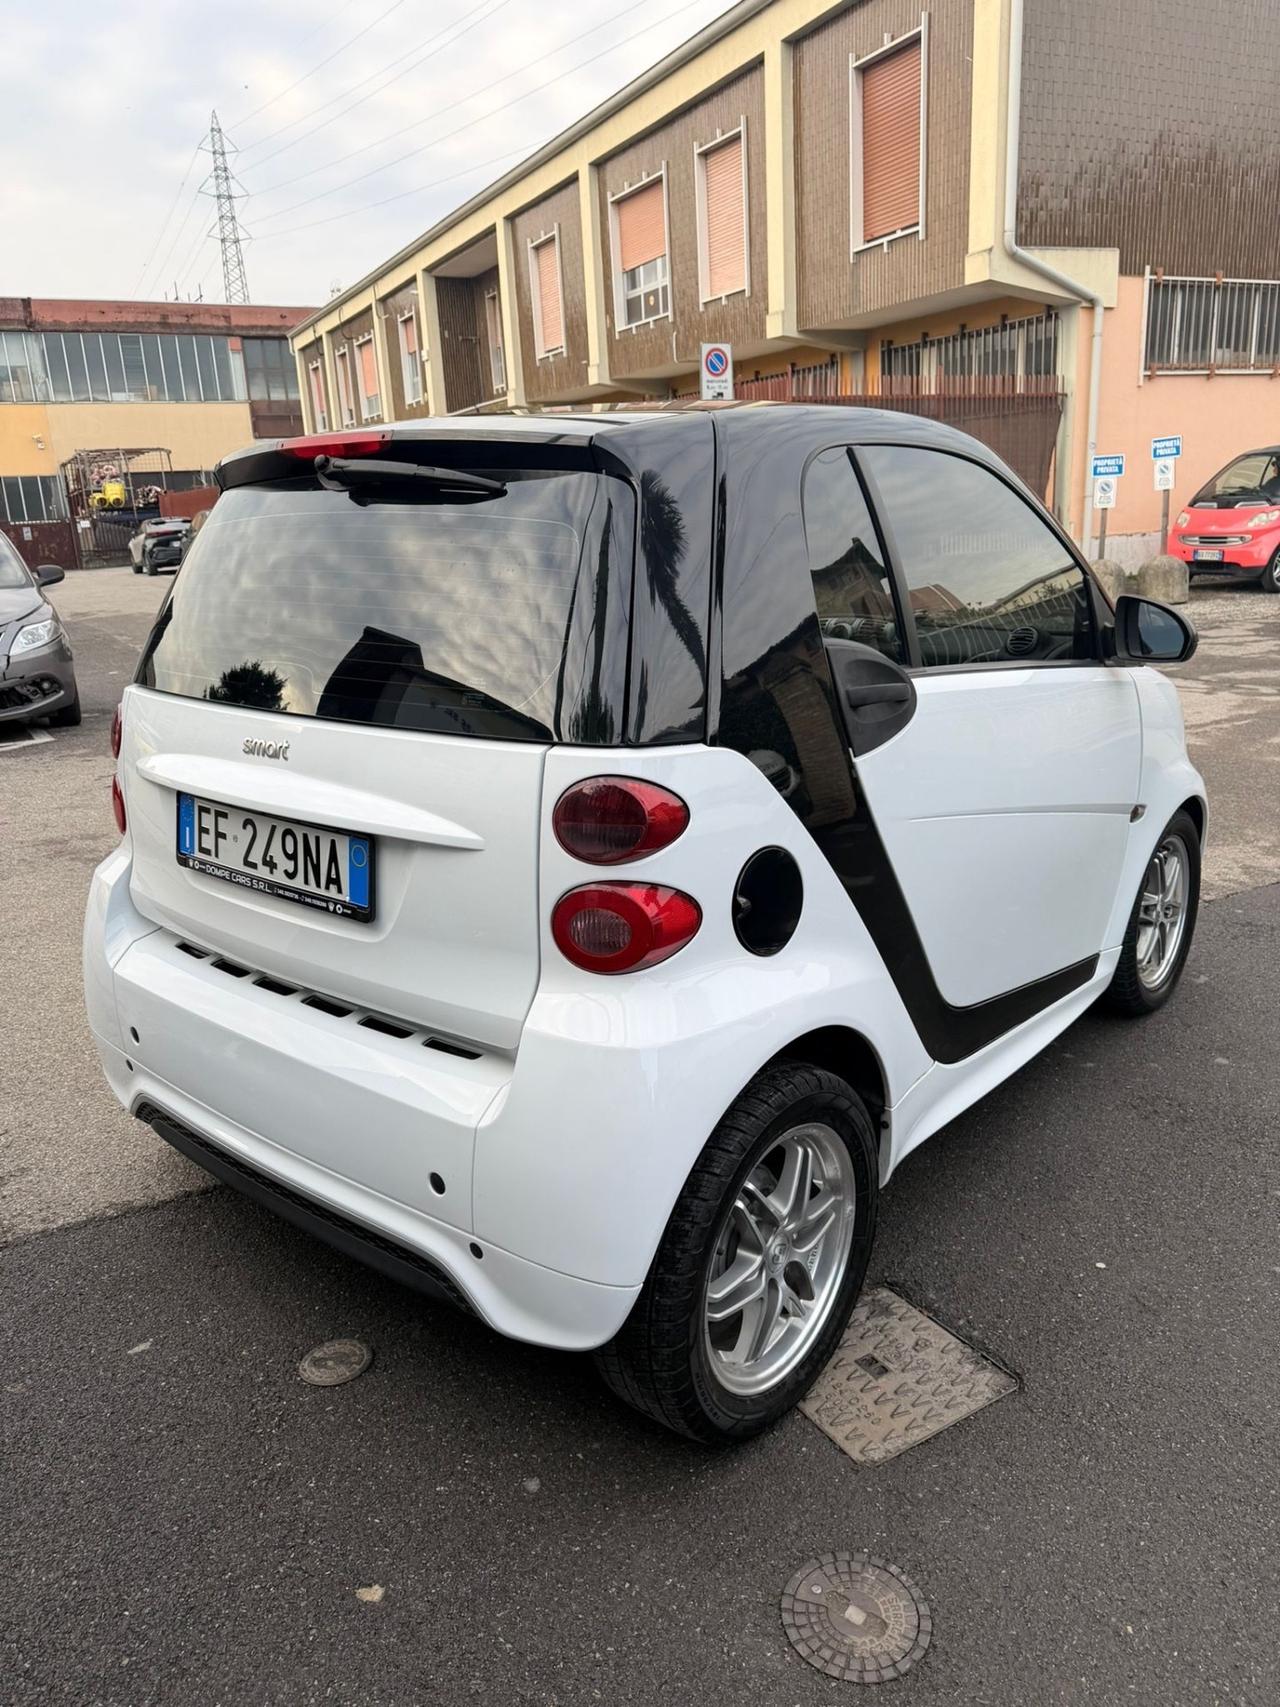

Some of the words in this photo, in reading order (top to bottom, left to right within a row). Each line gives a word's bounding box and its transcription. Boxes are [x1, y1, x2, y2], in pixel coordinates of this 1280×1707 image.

[1156, 447, 1177, 456] PRIVATA
[1096, 465, 1119, 474] PRIVATA
[241, 737, 290, 761] smart
[198, 804, 229, 859] EF
[242, 818, 343, 895] 249NA
[231, 872, 252, 887] CARS
